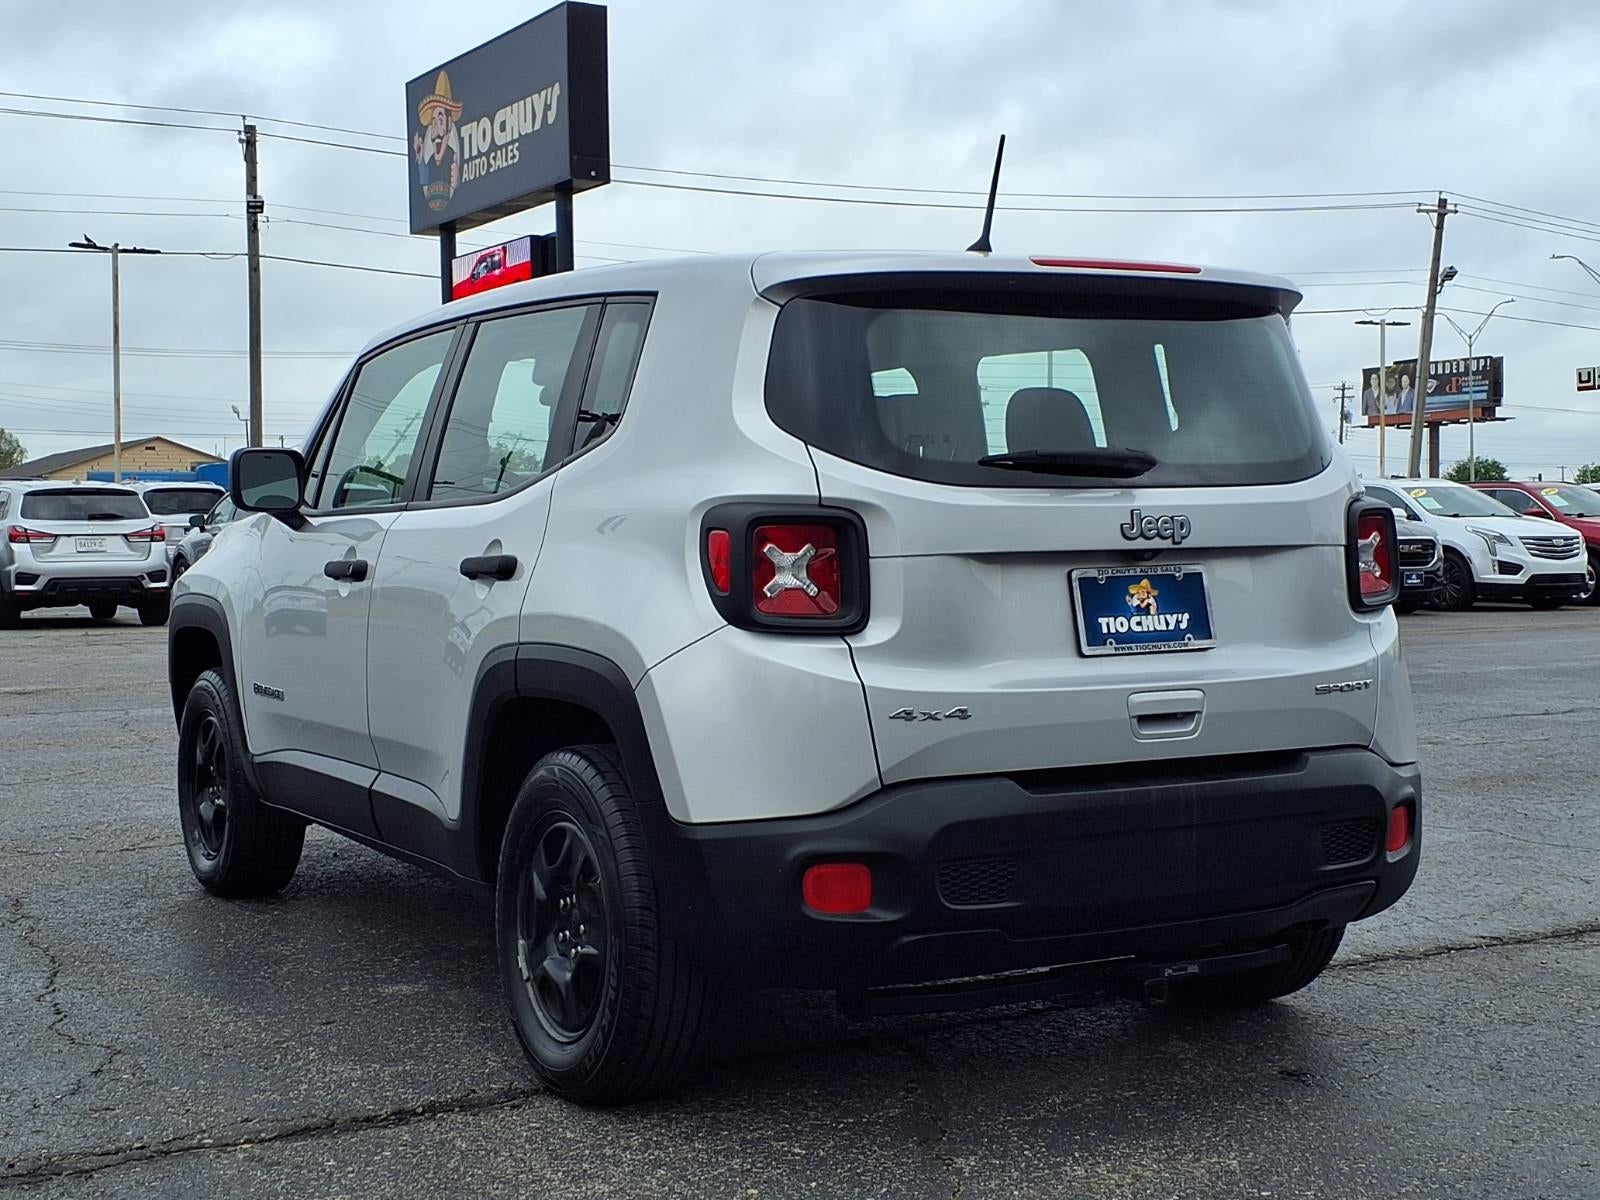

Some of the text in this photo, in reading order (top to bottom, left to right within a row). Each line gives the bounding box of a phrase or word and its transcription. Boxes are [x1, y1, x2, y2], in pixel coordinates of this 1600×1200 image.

[461, 82, 560, 159] TIO CHUY'S
[462, 143, 519, 183] AUTO SALES
[1429, 358, 1491, 375] UNDER UP!
[1120, 509, 1191, 544] Jeep
[1111, 567, 1137, 575] CHUY'S
[1160, 566, 1182, 574] SALES
[1098, 612, 1190, 634] TIO CHUY'S
[1315, 679, 1374, 695] SPORT
[888, 706, 972, 721] 4x4
